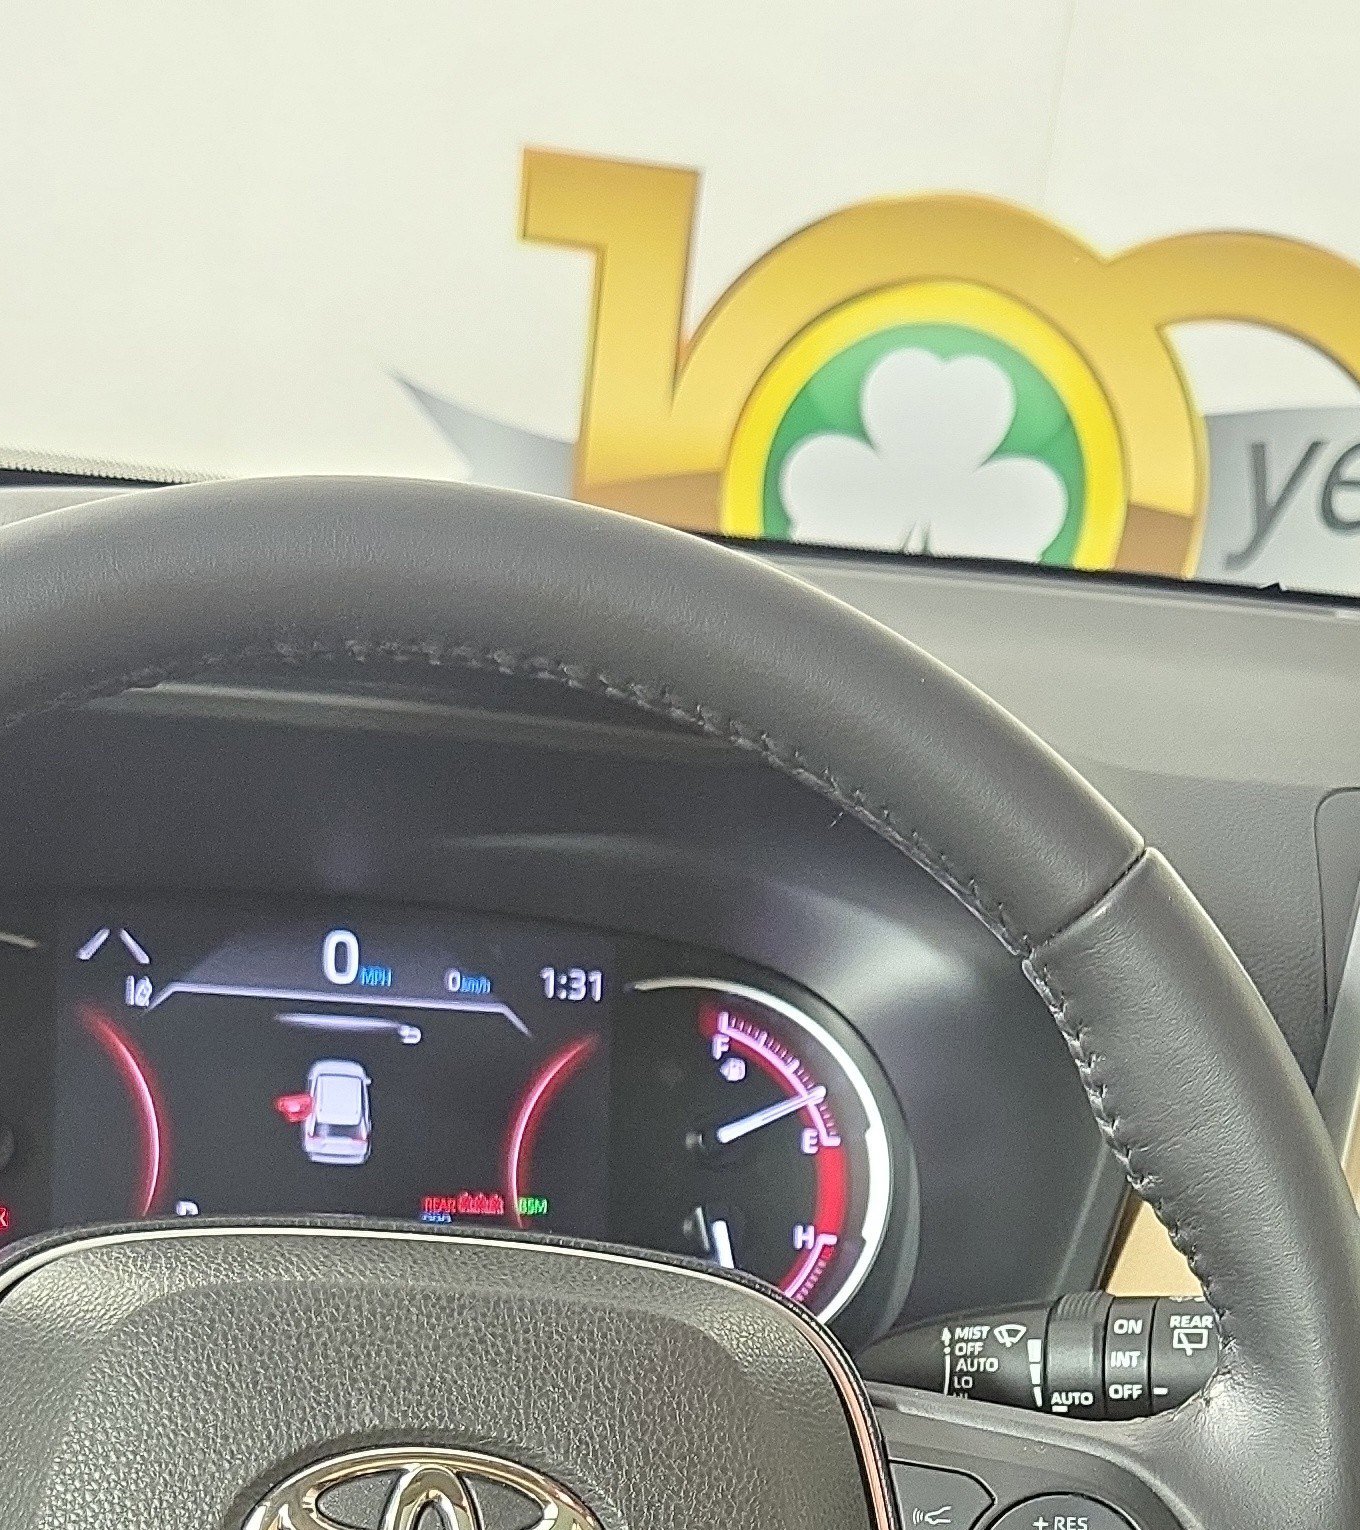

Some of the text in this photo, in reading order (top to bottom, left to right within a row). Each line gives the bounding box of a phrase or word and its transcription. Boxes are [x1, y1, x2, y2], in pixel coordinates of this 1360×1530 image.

[323, 928, 393, 987] 0 MPH
[540, 967, 603, 1001] 1:31
[712, 1033, 730, 1060] F
[801, 1128, 818, 1154] E
[793, 1225, 815, 1250] H
[1113, 1319, 1143, 1335] ON
[1169, 1315, 1214, 1329] REAR
[954, 1325, 991, 1340] MIST
[955, 1342, 983, 1356] OFF
[956, 1357, 999, 1372] AUTO
[1110, 1351, 1140, 1367] INT
[953, 1376, 973, 1389] LO
[1051, 1391, 1094, 1406] AUTO
[1108, 1384, 1143, 1400] OFF
